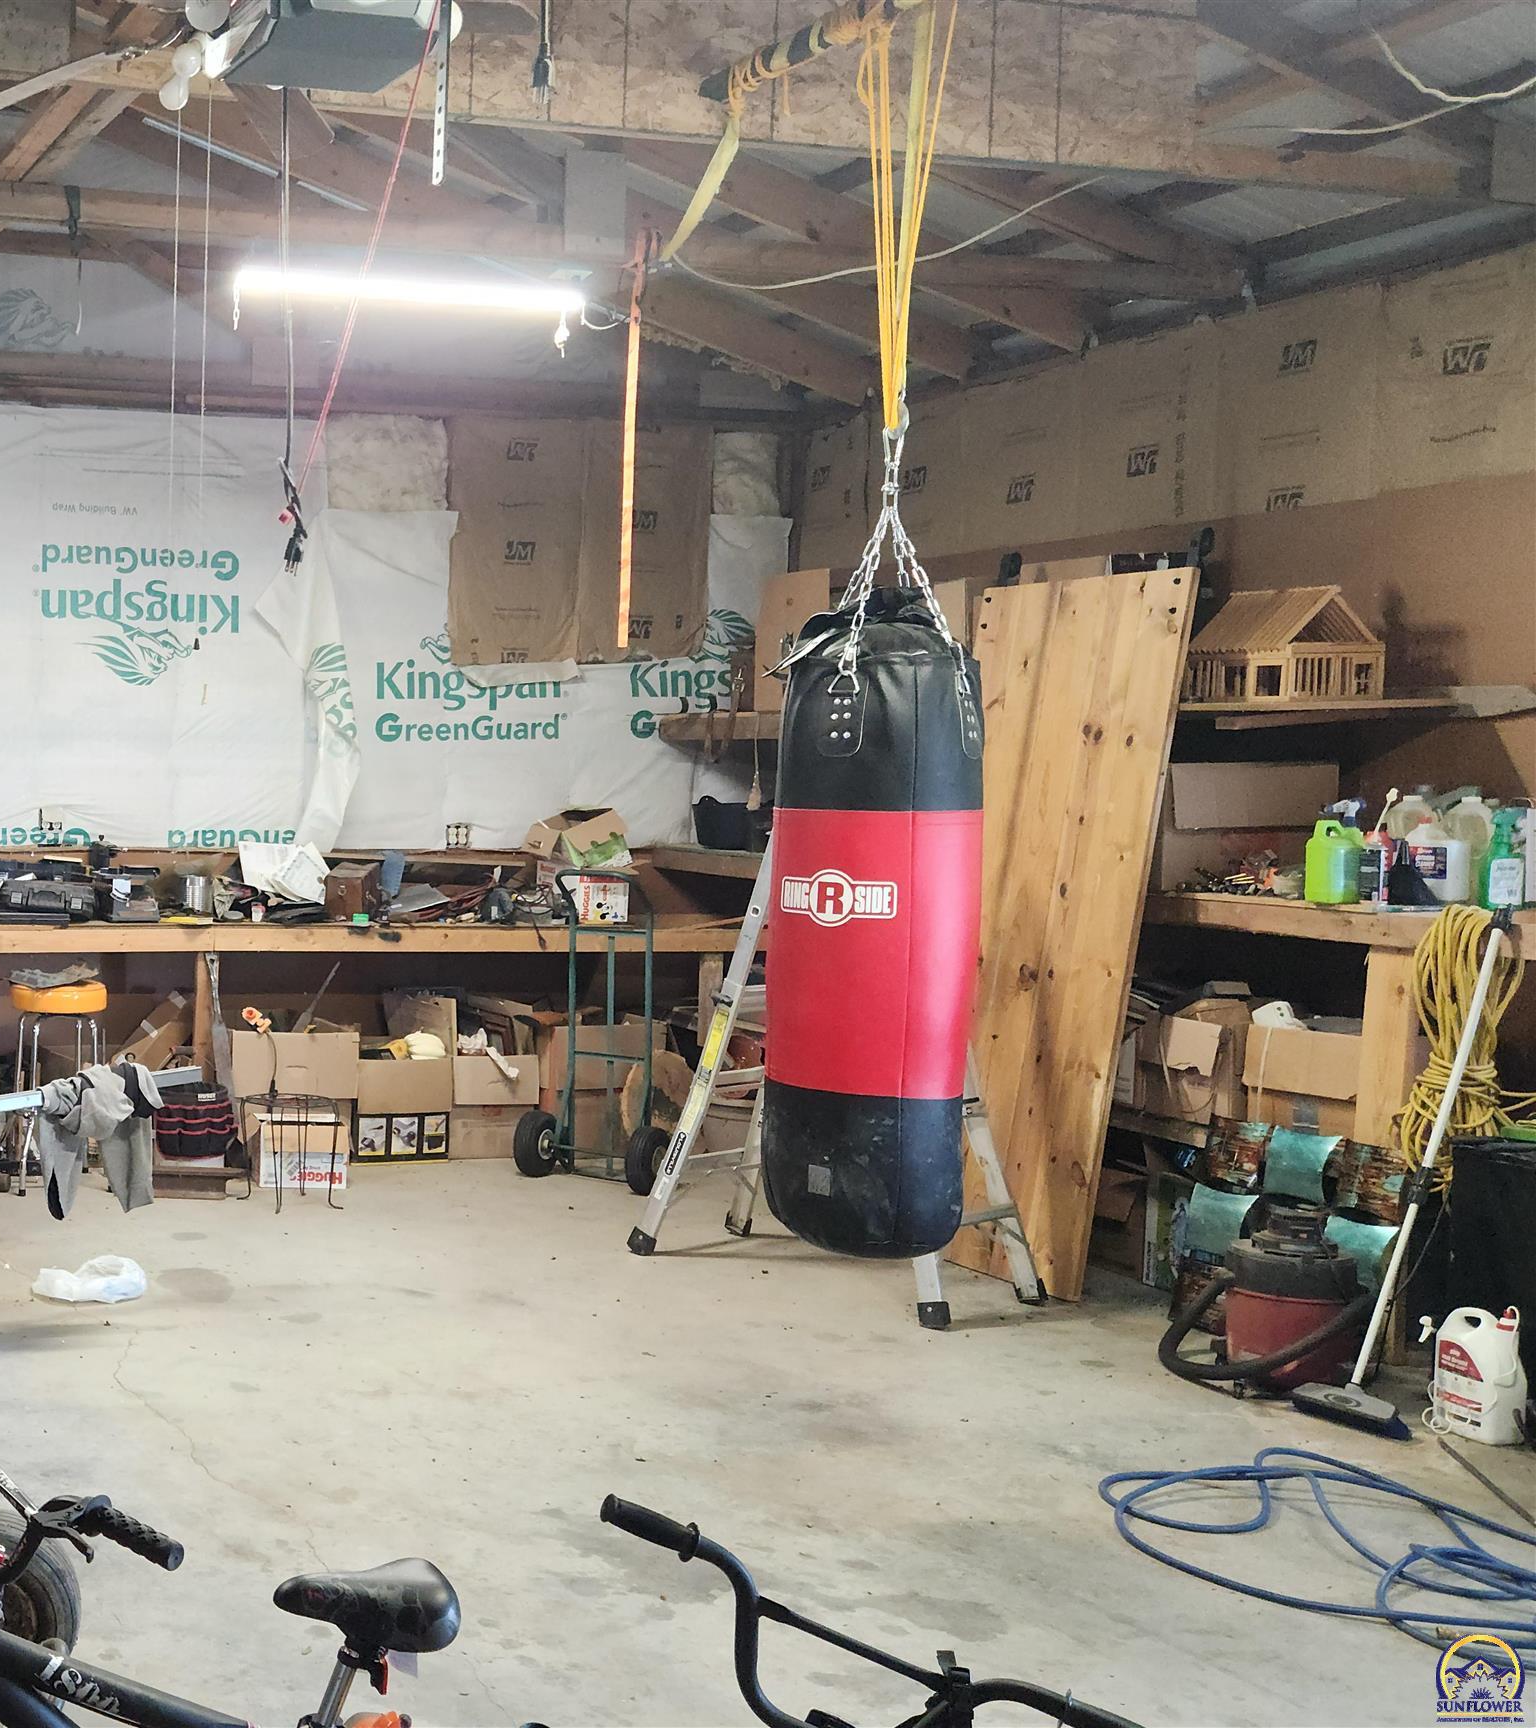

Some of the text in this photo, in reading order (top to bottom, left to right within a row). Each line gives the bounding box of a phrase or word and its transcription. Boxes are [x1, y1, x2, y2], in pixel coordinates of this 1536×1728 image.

[52, 502, 76, 513] Wrap
[79, 503, 116, 516] Building
[41, 544, 240, 581] GreenGuard
[41, 579, 240, 635] Kingspan
[629, 660, 732, 713] Kings
[376, 712, 561, 743] GreenGuard
[581, 885, 591, 921] HUGGIES
[784, 881, 891, 914] RING R SIDE
